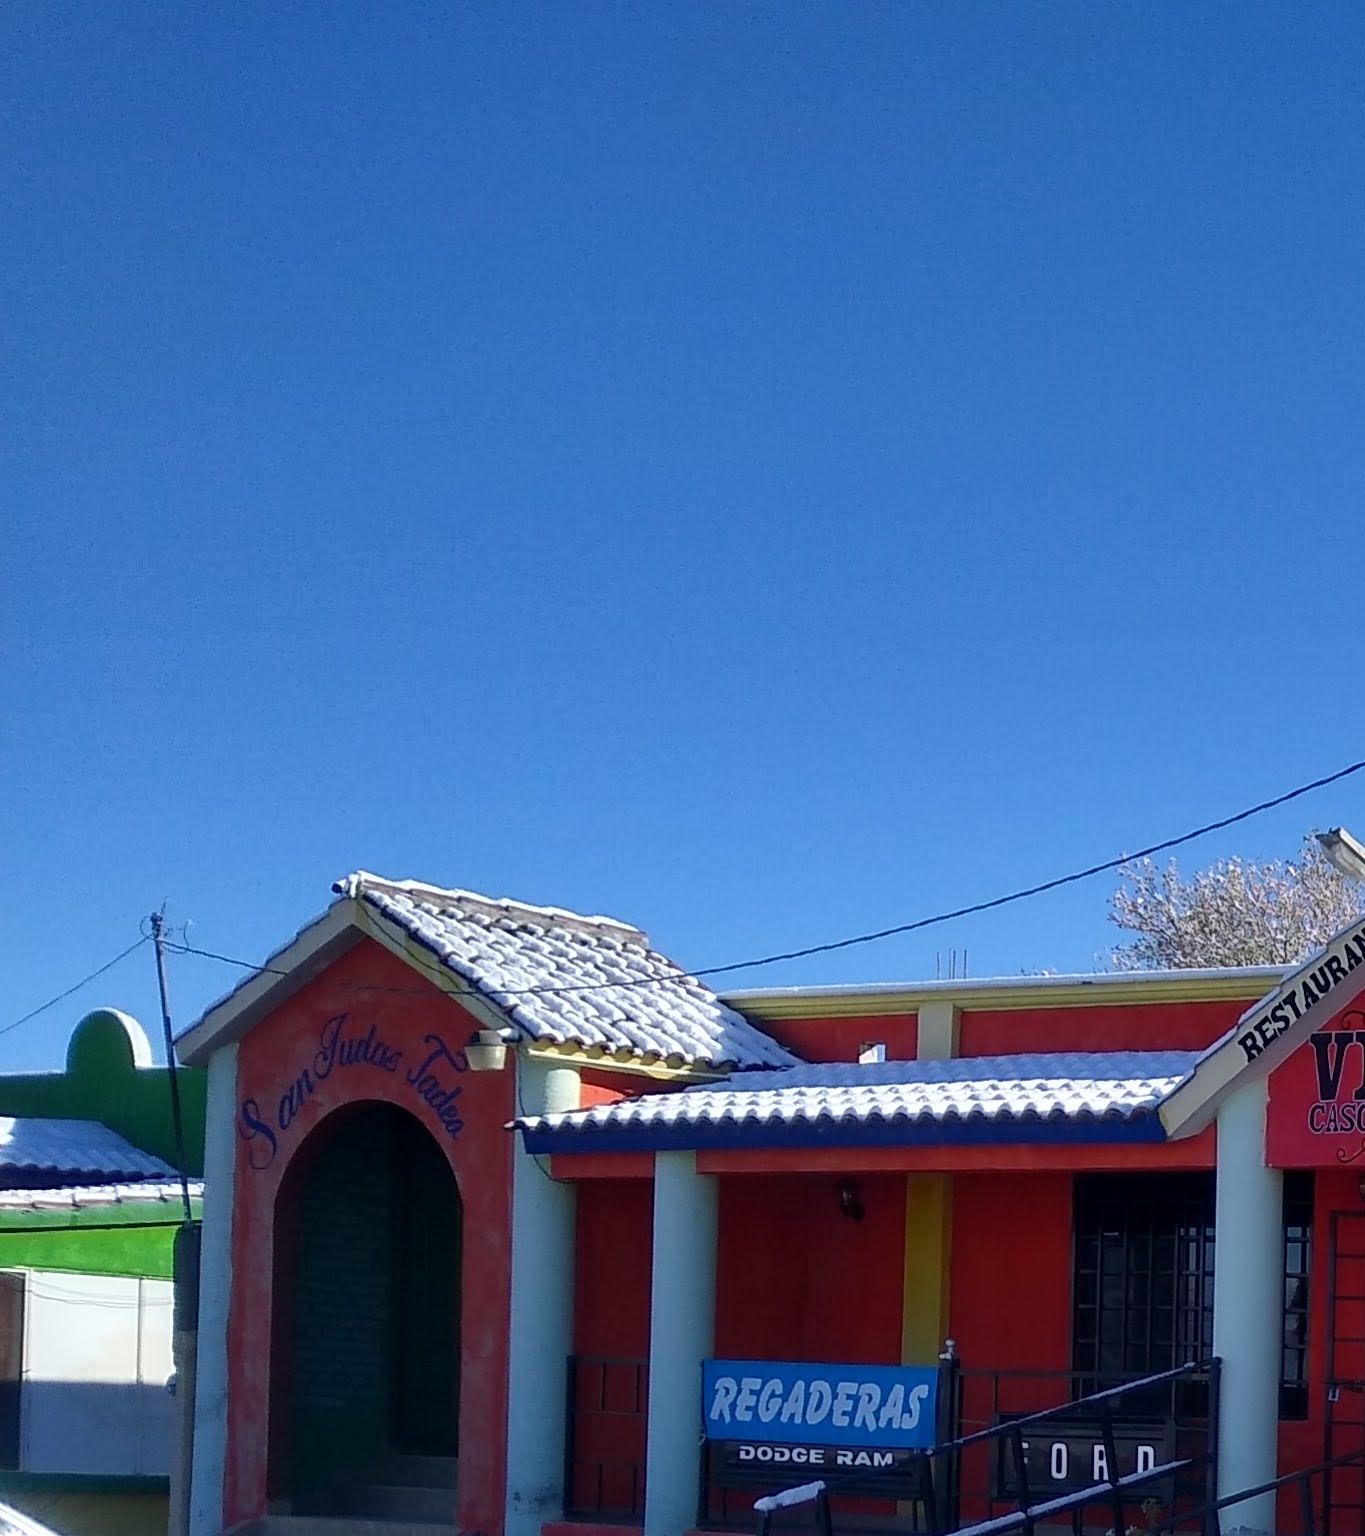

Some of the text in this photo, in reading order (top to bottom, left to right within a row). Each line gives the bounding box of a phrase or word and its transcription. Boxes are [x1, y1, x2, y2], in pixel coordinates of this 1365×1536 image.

[238, 1012, 469, 1170] San Judas Tadeo
[709, 1376, 930, 1432] REGADERAS
[738, 1445, 893, 1467] DODGE RAM
